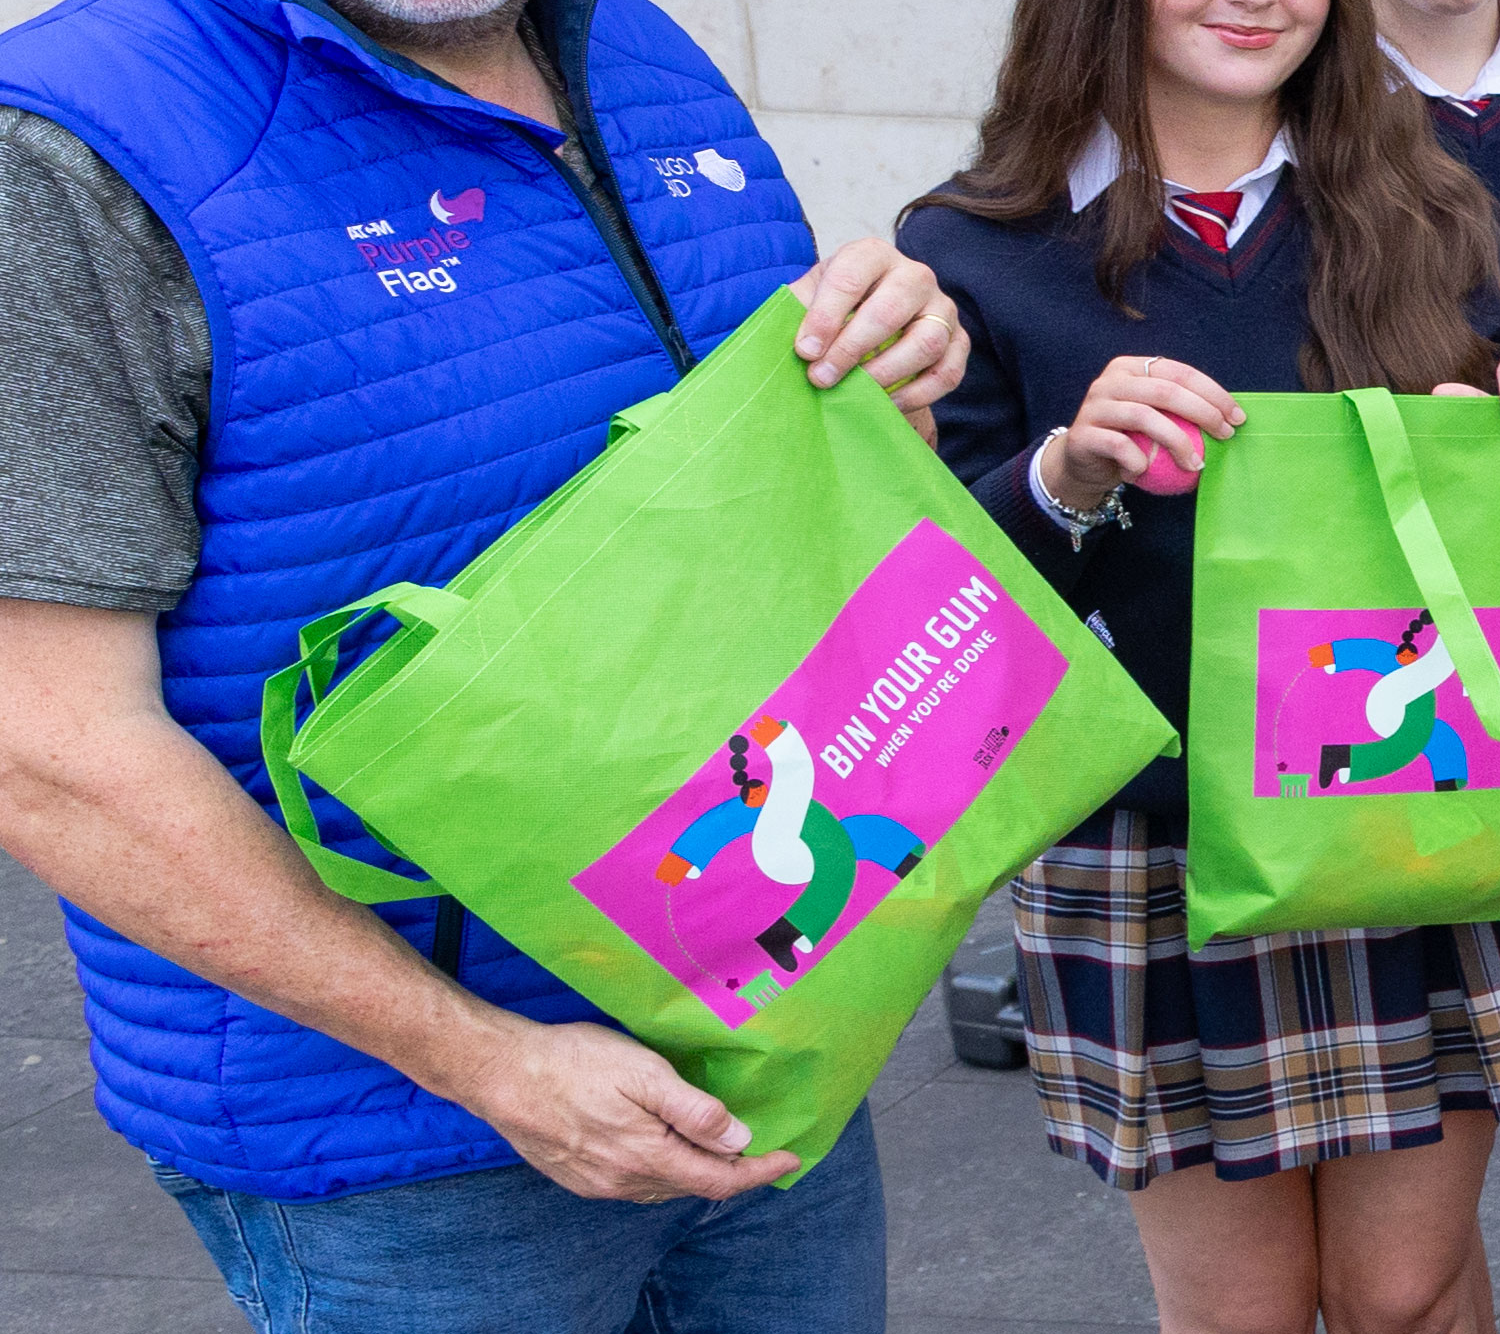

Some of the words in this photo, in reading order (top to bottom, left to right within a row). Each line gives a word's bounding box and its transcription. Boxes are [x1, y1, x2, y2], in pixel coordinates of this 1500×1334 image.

[357, 227, 471, 267] Purple
[820, 718, 878, 779] BIN
[859, 639, 939, 729] YOUR
[927, 574, 999, 646] GUM
[876, 723, 915, 768] WHEN
[905, 667, 963, 731] YOU'RE
[949, 629, 998, 683] DONE
